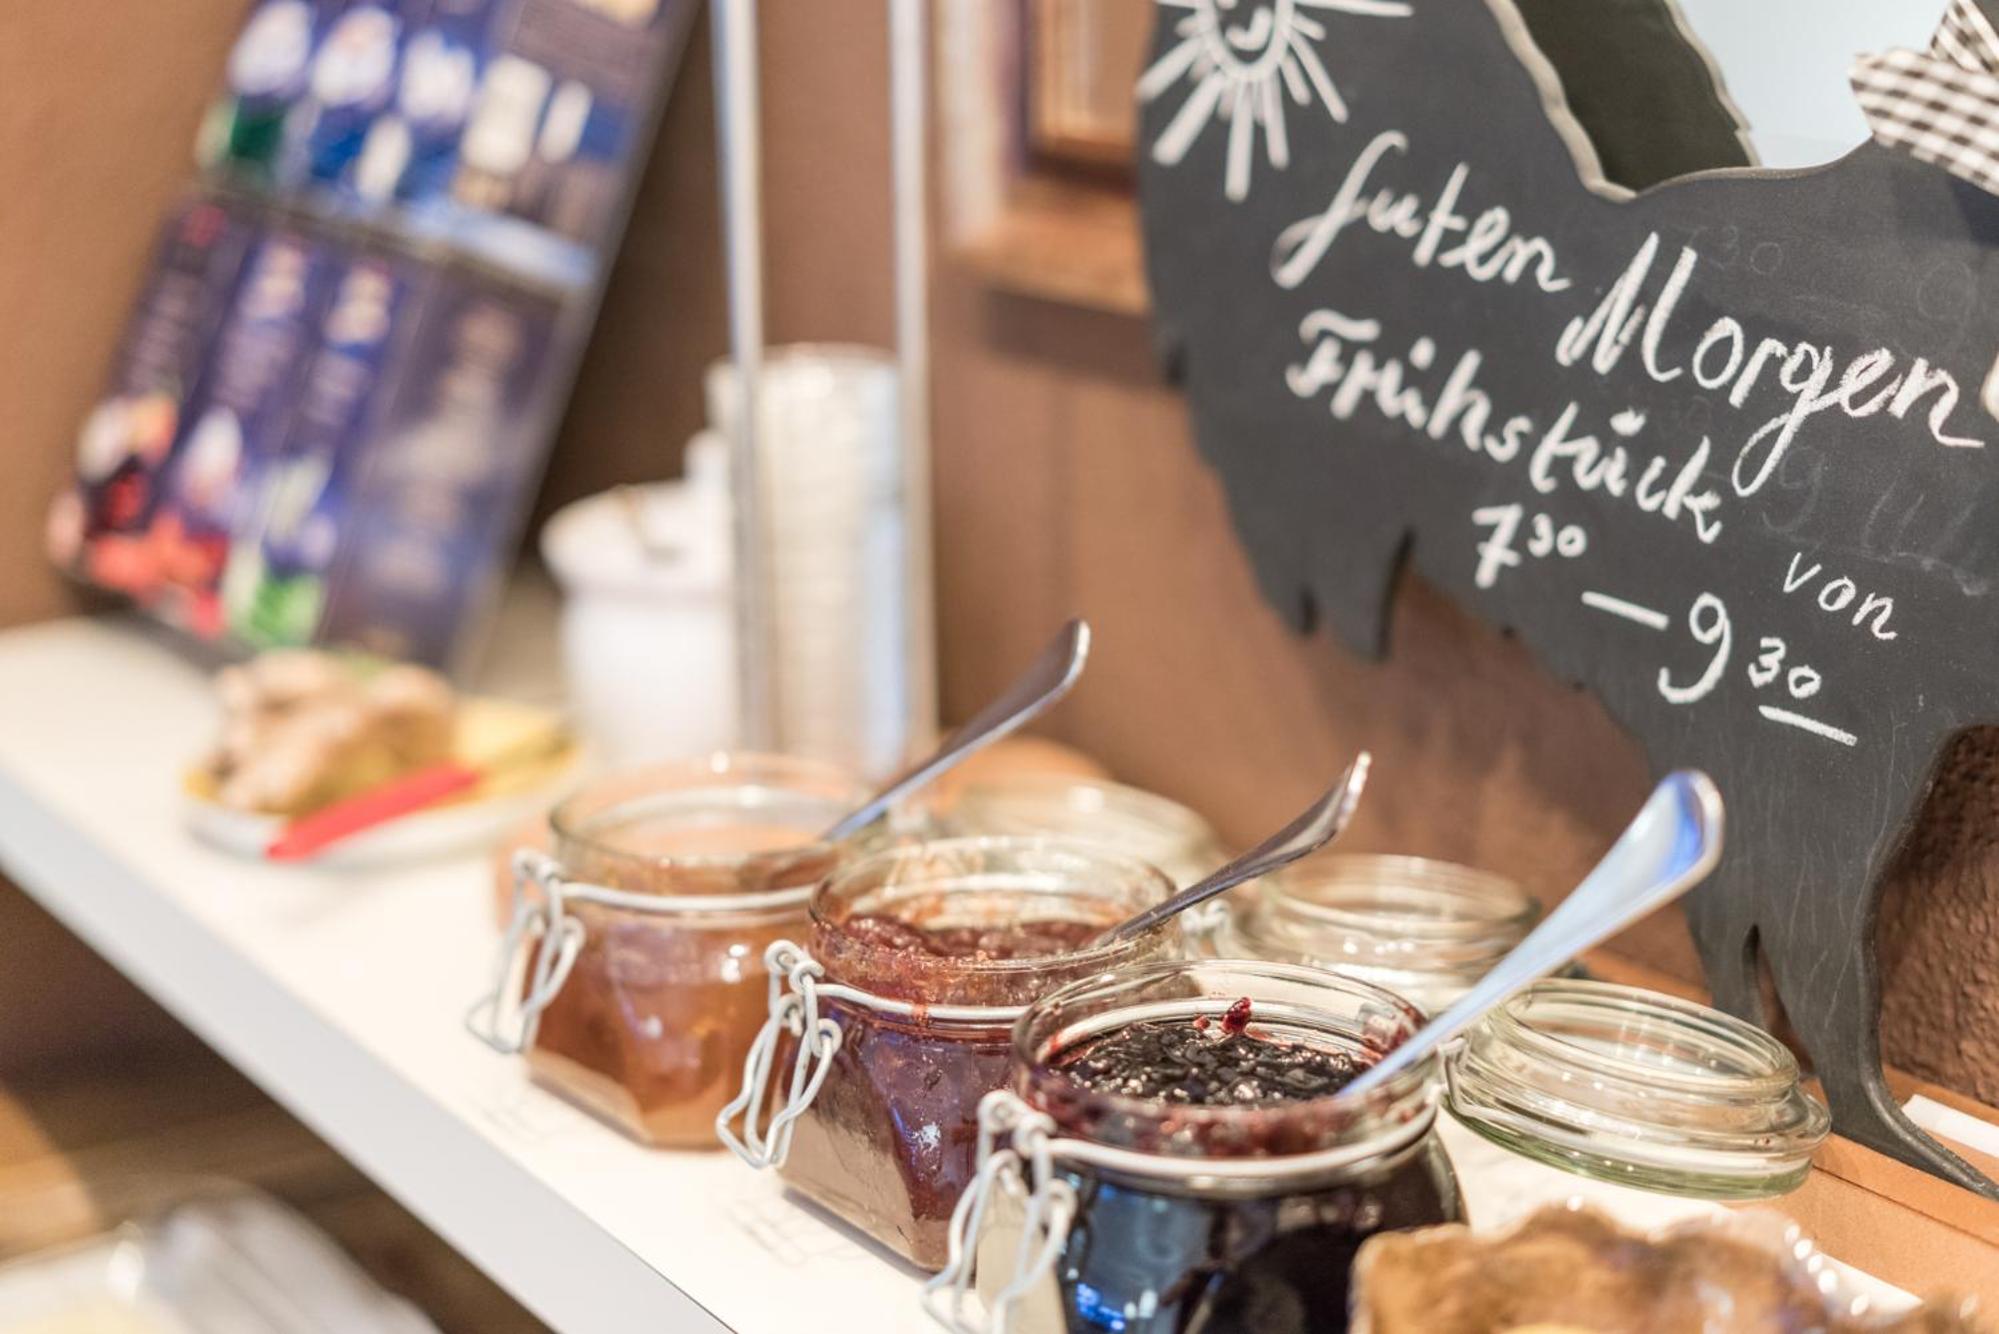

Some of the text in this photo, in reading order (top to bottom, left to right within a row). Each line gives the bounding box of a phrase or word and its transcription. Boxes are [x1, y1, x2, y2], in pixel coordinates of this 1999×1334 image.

[1273, 131, 1984, 496] Guten Morgen
[1286, 310, 1722, 543] Frühstück
[1784, 552, 1897, 640] von
